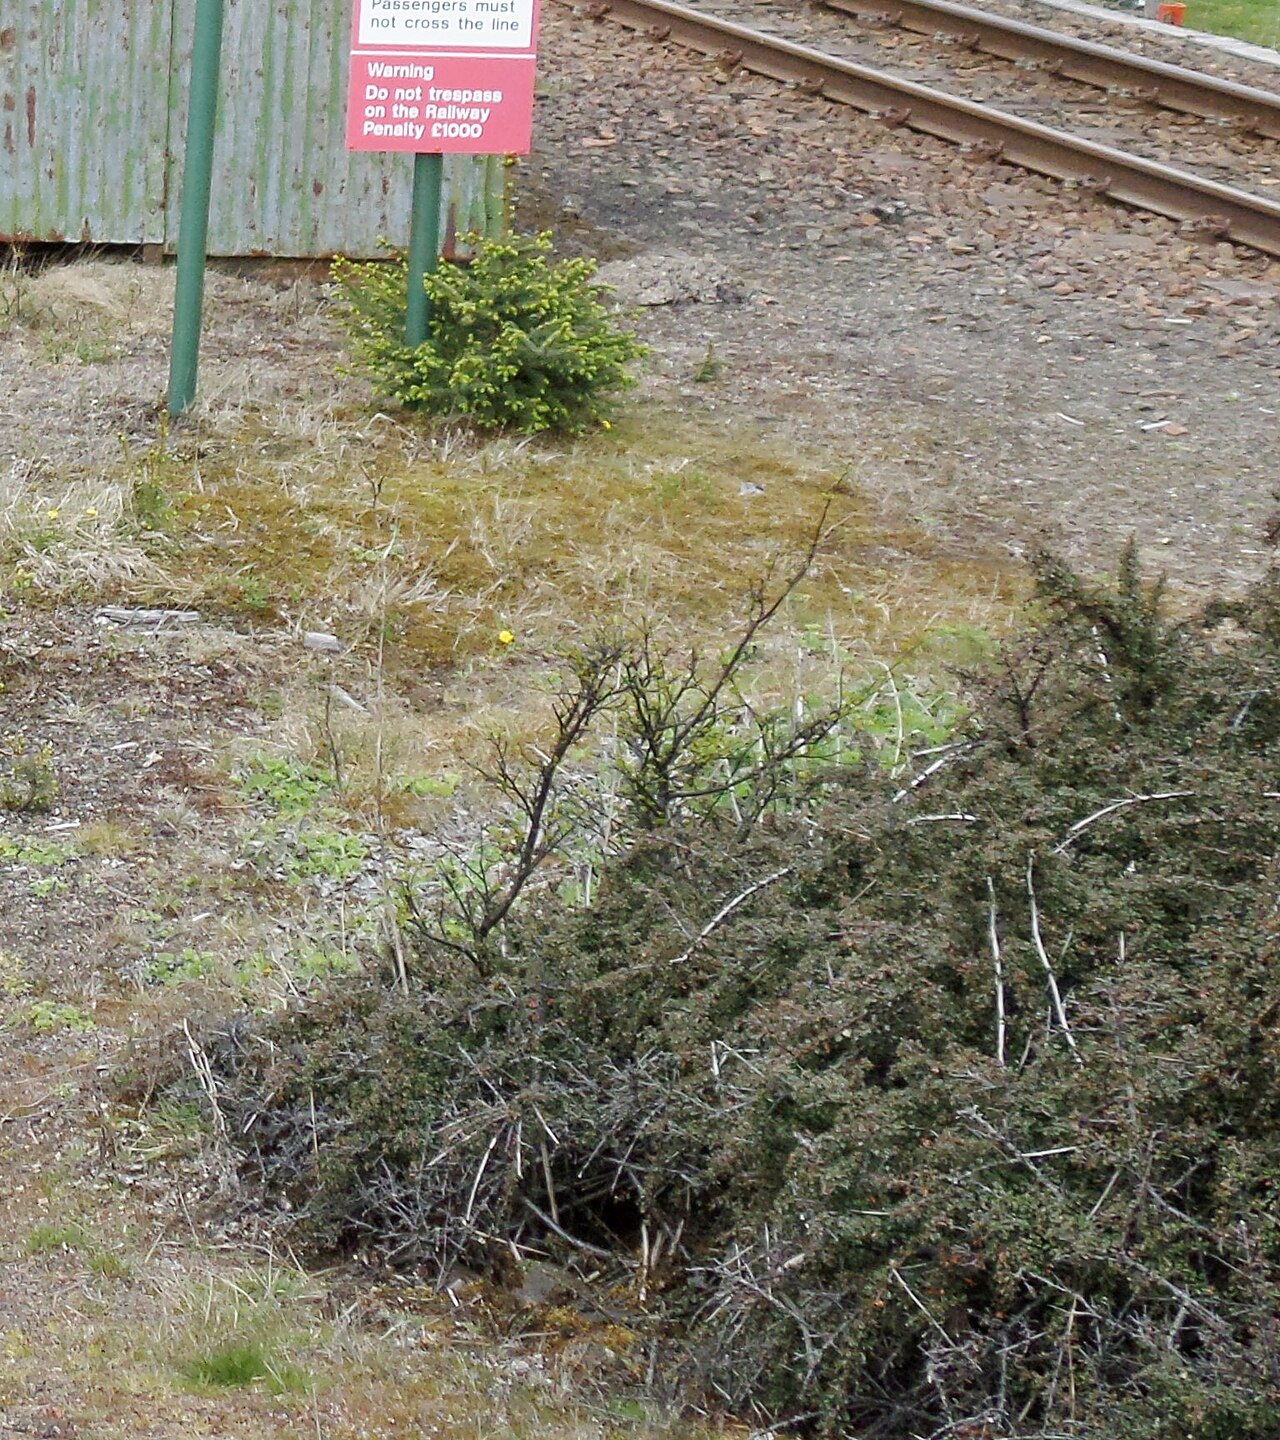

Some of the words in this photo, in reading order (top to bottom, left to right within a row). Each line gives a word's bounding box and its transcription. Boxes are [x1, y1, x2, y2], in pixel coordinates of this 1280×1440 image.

[475, 0, 515, 12] must
[370, 16, 396, 29] not
[404, 19, 449, 30] cross
[458, 18, 483, 31] the
[491, 18, 519, 31] line
[368, 63, 433, 80] Warning
[365, 85, 389, 101] Do
[395, 86, 422, 101] not
[429, 87, 502, 104] trespass
[364, 105, 385, 118] on
[392, 104, 419, 119] the
[425, 105, 490, 122] Railway
[363, 122, 424, 139] Penalty
[431, 123, 482, 138] £1000
